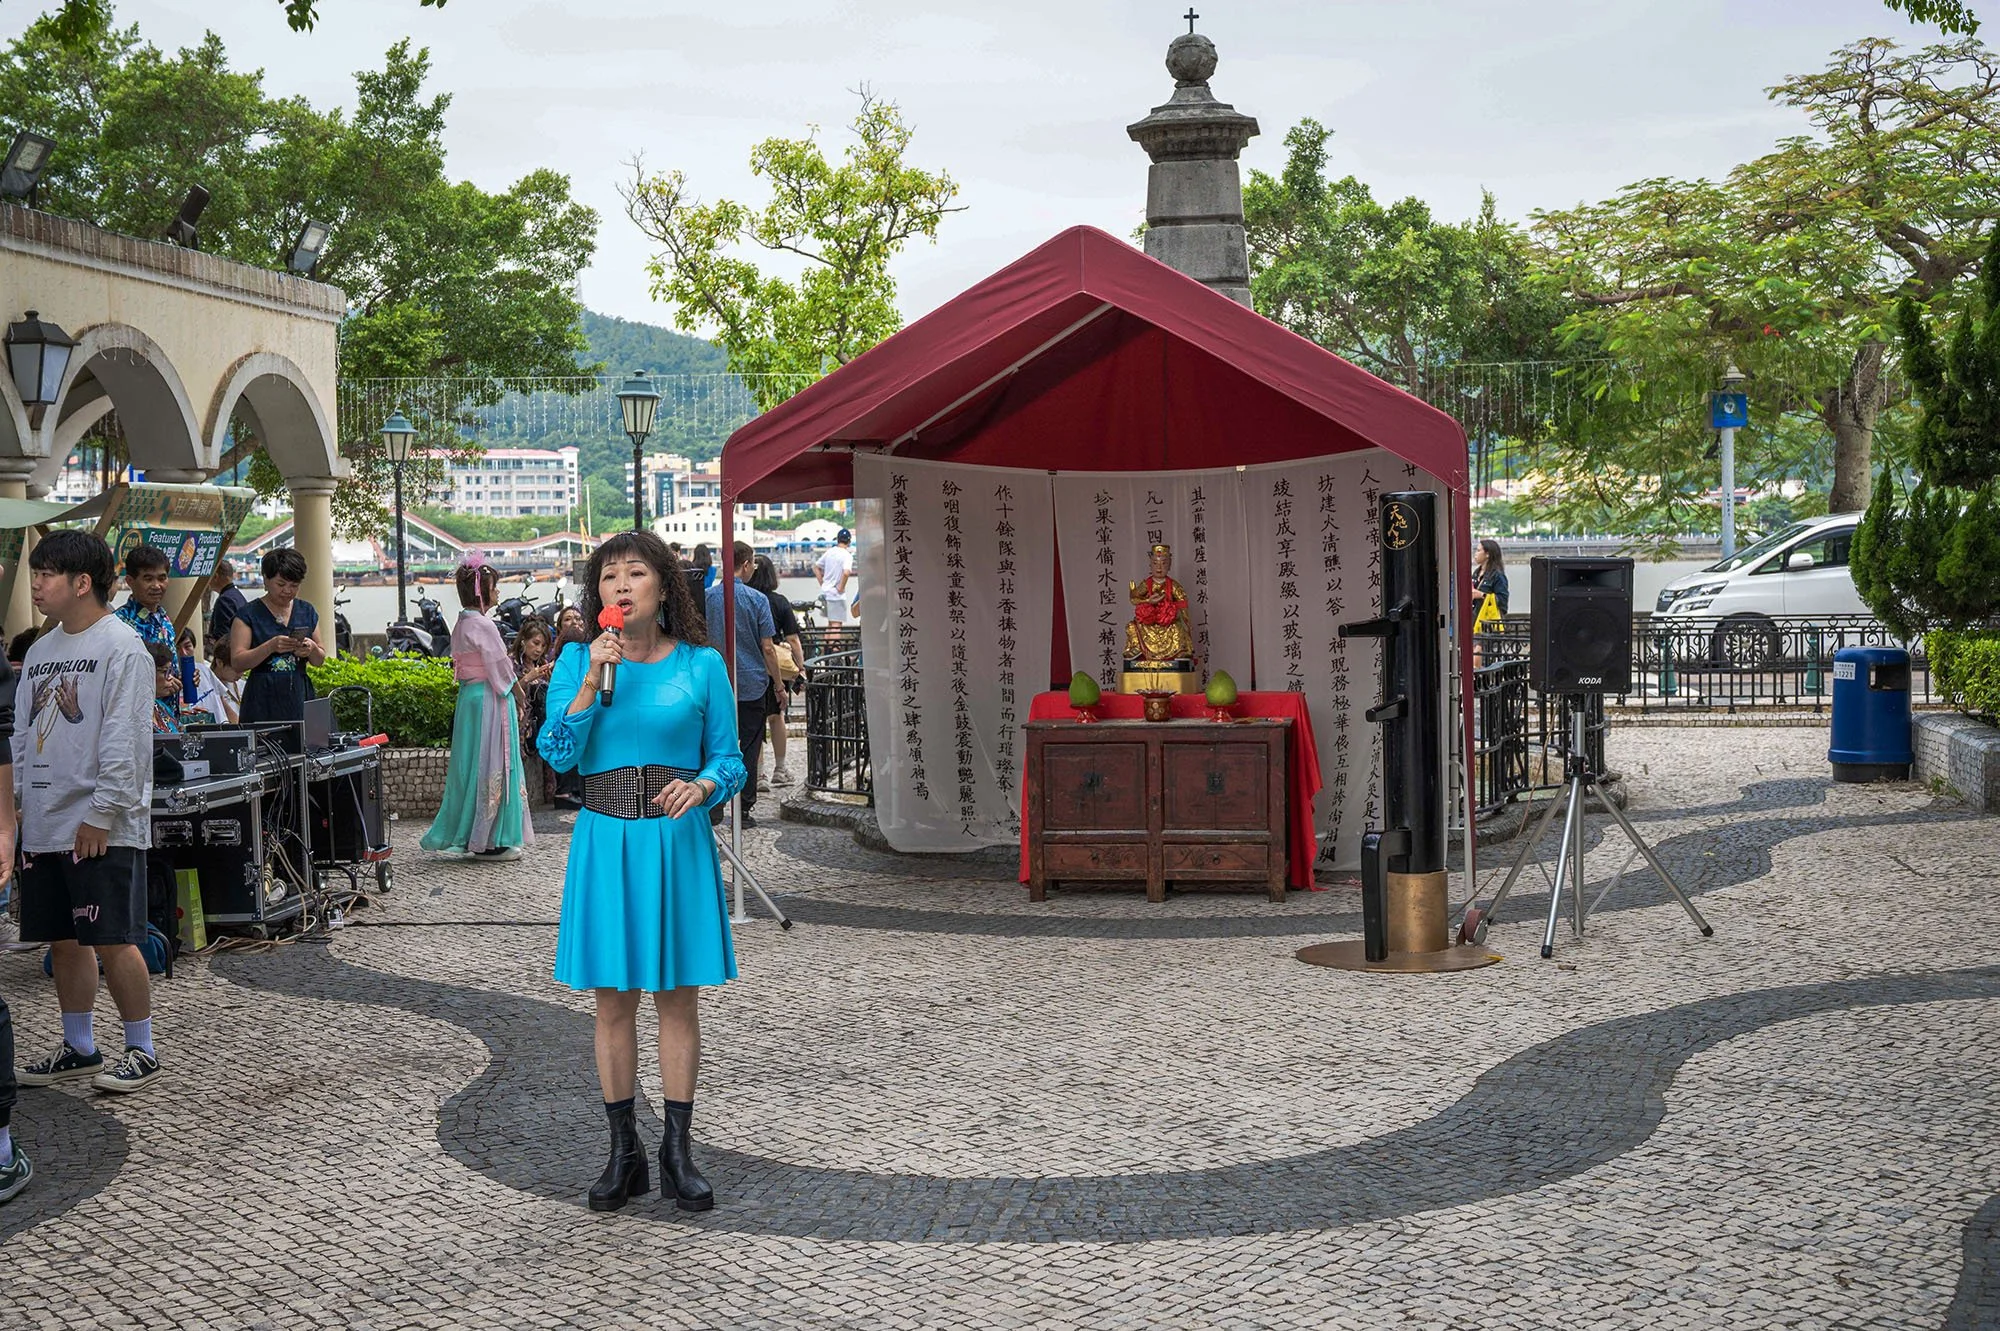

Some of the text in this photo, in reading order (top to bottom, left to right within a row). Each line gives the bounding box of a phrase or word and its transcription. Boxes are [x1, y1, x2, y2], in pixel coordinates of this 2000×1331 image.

[148, 531, 222, 545] Featured Products
[27, 659, 98, 680] RAGINGLION
